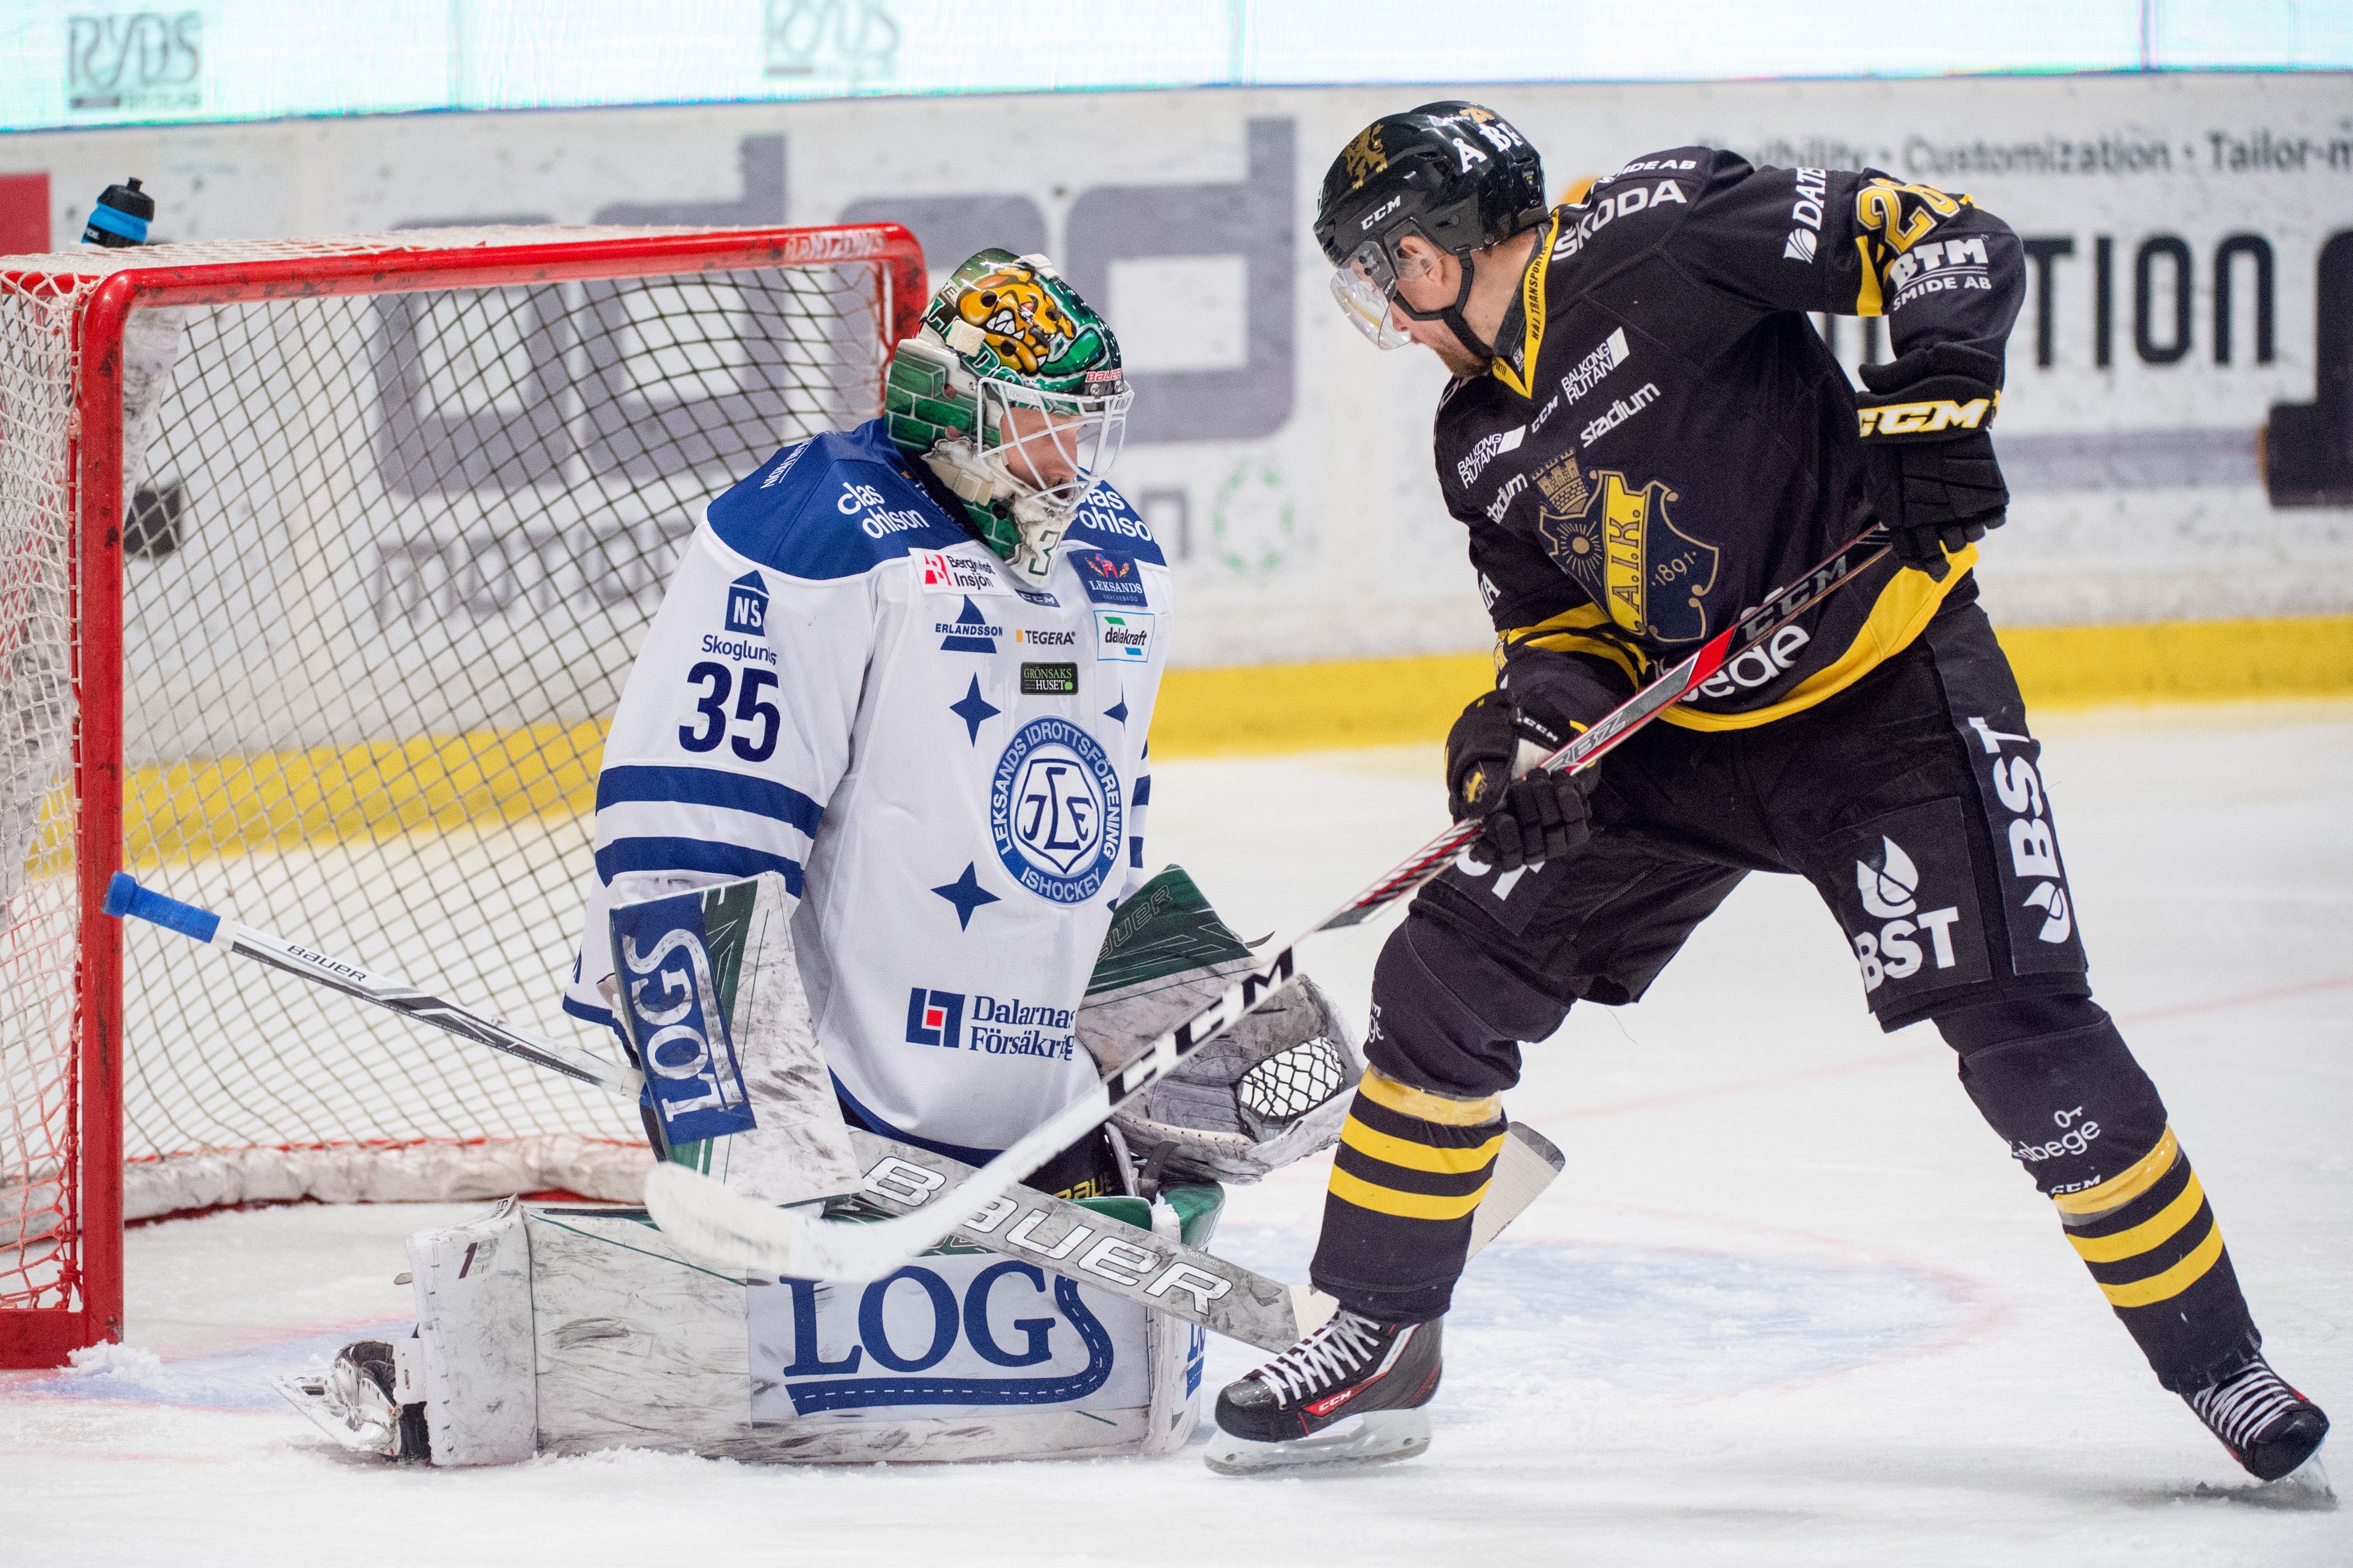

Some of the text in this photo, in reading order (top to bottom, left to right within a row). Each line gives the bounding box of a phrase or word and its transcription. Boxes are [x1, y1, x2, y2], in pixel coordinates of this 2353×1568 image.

[1904, 129, 2169, 176] Customization
[1361, 195, 1401, 230] CCM
[1551, 179, 1687, 261] ŠKODA
[1890, 238, 1989, 292] BTM
[1893, 276, 1992, 312] SMIDE AB
[1561, 337, 1610, 391] BALKONG
[1565, 355, 1614, 406] RUTAN
[1530, 395, 1559, 434] CCM
[1580, 382, 1661, 448] stadium
[1457, 433, 1502, 476] BALKONG
[1461, 444, 1498, 489] RUTAN
[837, 482, 885, 515] clas
[862, 506, 930, 539] ohlson
[947, 555, 995, 575] Bergkvist
[954, 572, 994, 590] Insjön
[1089, 580, 1142, 594] LEKSANDS
[1741, 556, 1847, 639] CCM
[733, 596, 762, 628] NS
[935, 623, 1002, 637] ERLANDSSON
[1105, 627, 1147, 646] dalakraft
[1024, 666, 1072, 679] GRÖNSAKS
[1036, 680, 1065, 690] HUSET
[679, 661, 781, 763] 35
[1542, 712, 1625, 771] RBZ
[993, 722, 1119, 860] LEKSANDS IDROTTSFÖRENING
[1968, 716, 2061, 878] BST
[1020, 866, 1100, 902] ISHOCKEY
[1854, 907, 1959, 993] BST
[2050, 1174, 2101, 1195] CCM
[1318, 1390, 1352, 1412] CCM
